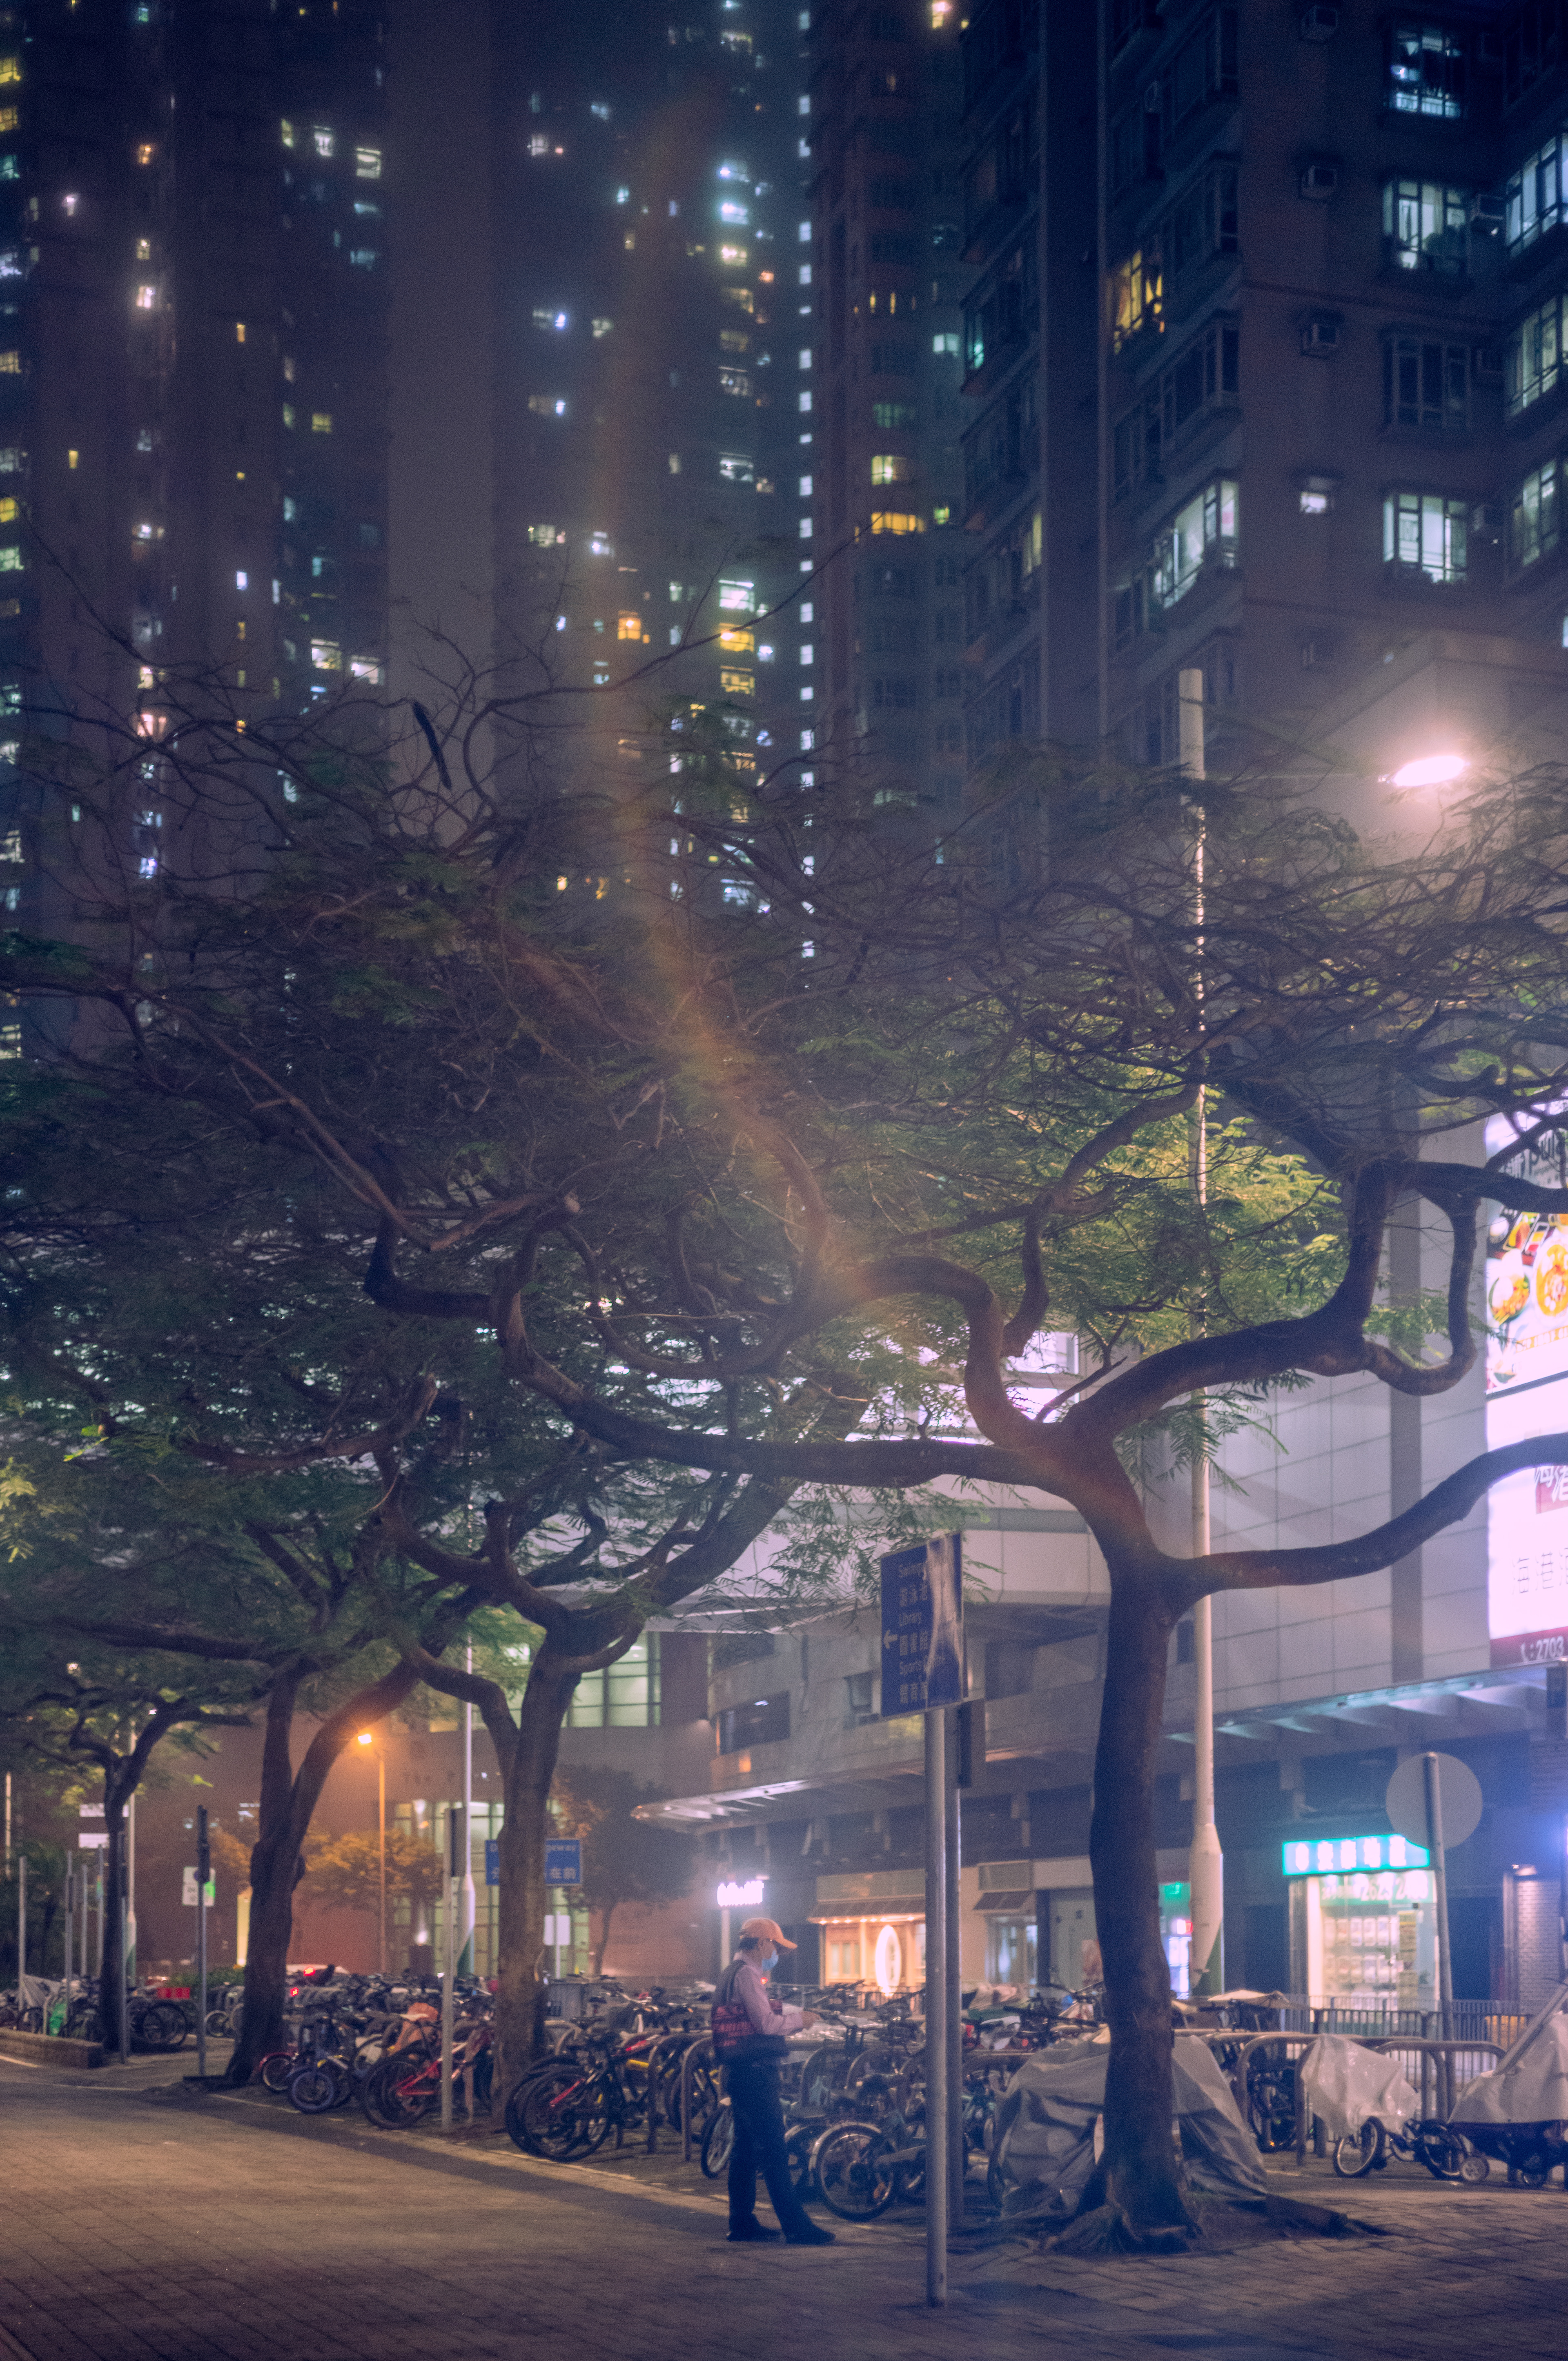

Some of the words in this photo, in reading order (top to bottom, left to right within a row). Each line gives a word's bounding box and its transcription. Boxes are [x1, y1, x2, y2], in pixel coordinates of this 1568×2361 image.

[899, 1583, 928, 1607] 游泳池
[899, 1611, 922, 1627] Library
[900, 1630, 928, 1656] 圖書館
[899, 1659, 922, 1677] Sports
[900, 1682, 928, 1704] 體育館
